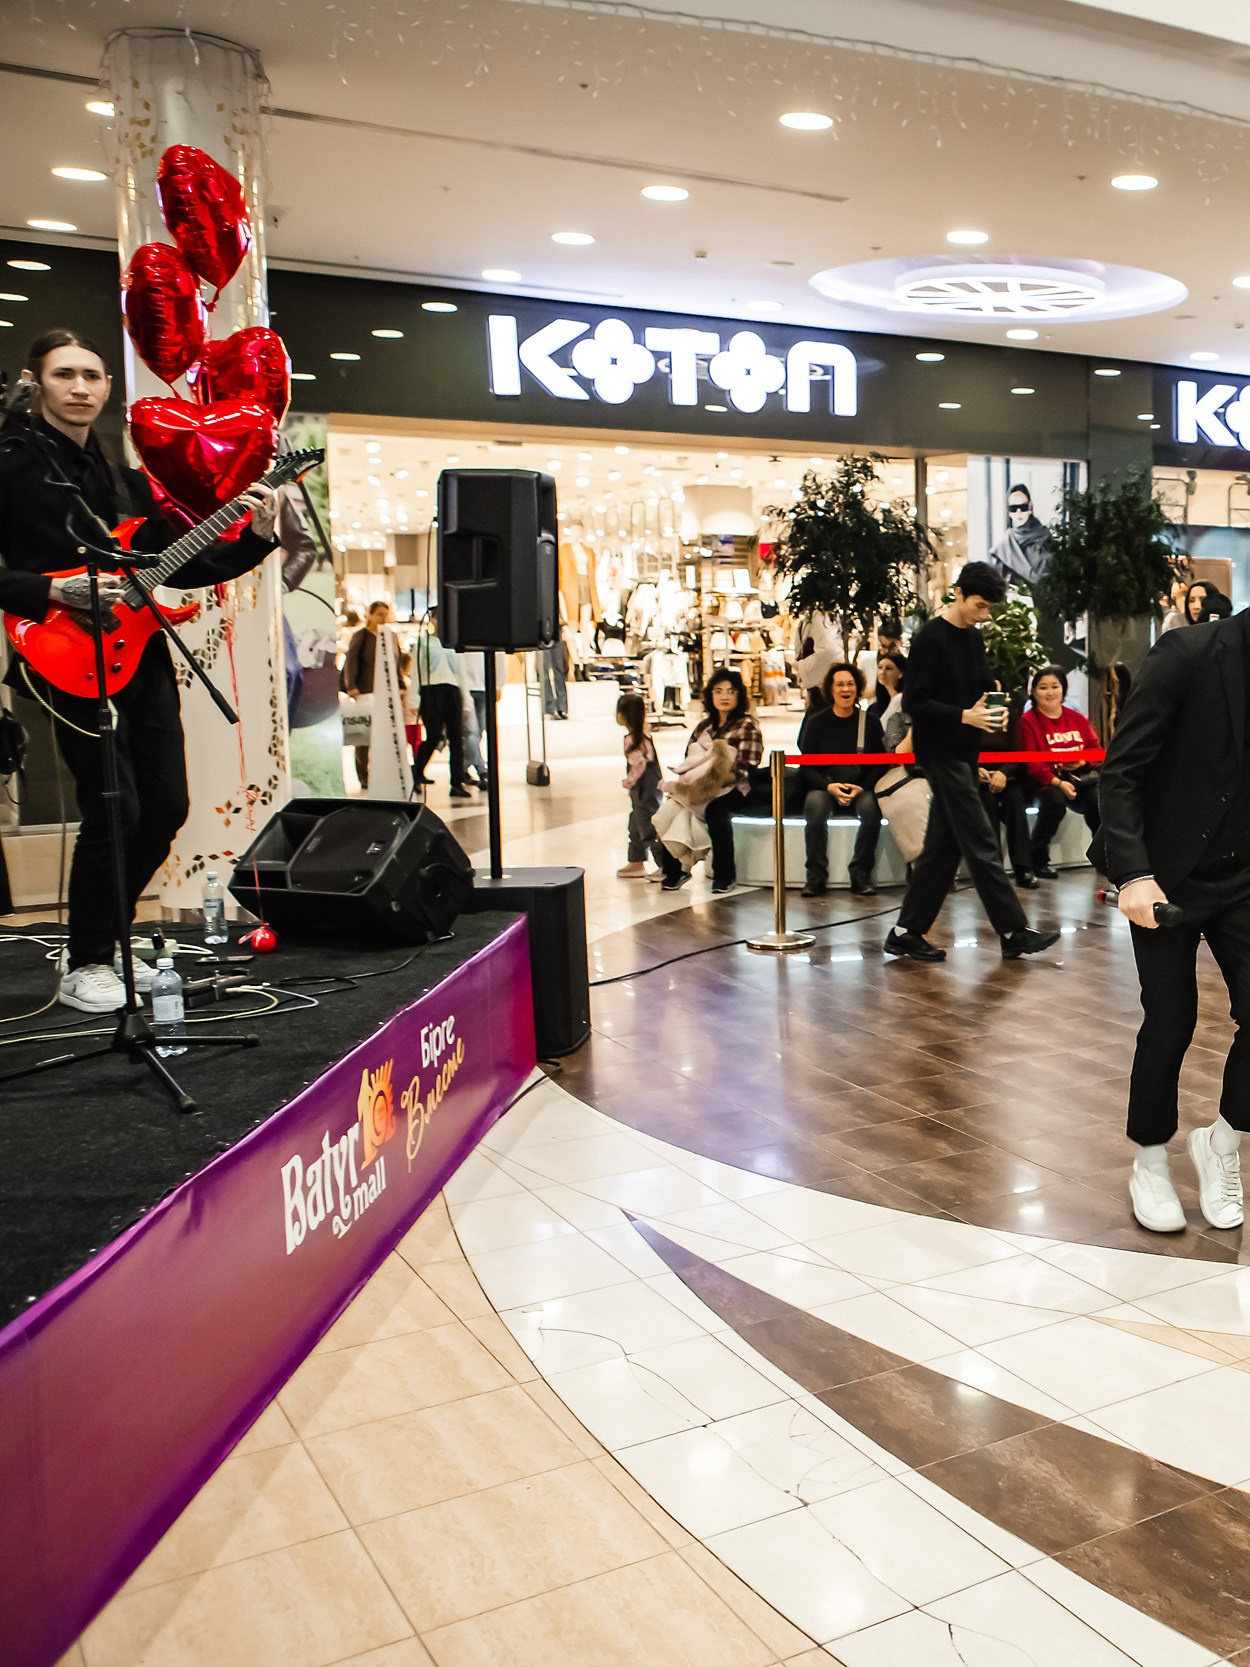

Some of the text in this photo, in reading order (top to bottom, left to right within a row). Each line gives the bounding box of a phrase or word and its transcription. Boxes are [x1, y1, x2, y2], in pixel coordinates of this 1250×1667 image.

[488, 314, 859, 417] KOTON
[342, 715, 372, 727] nsay
[1045, 730, 1084, 745] LOVE
[421, 1015, 456, 1068] Бірге
[281, 1122, 359, 1255] Batyr
[354, 1156, 387, 1221] mall
